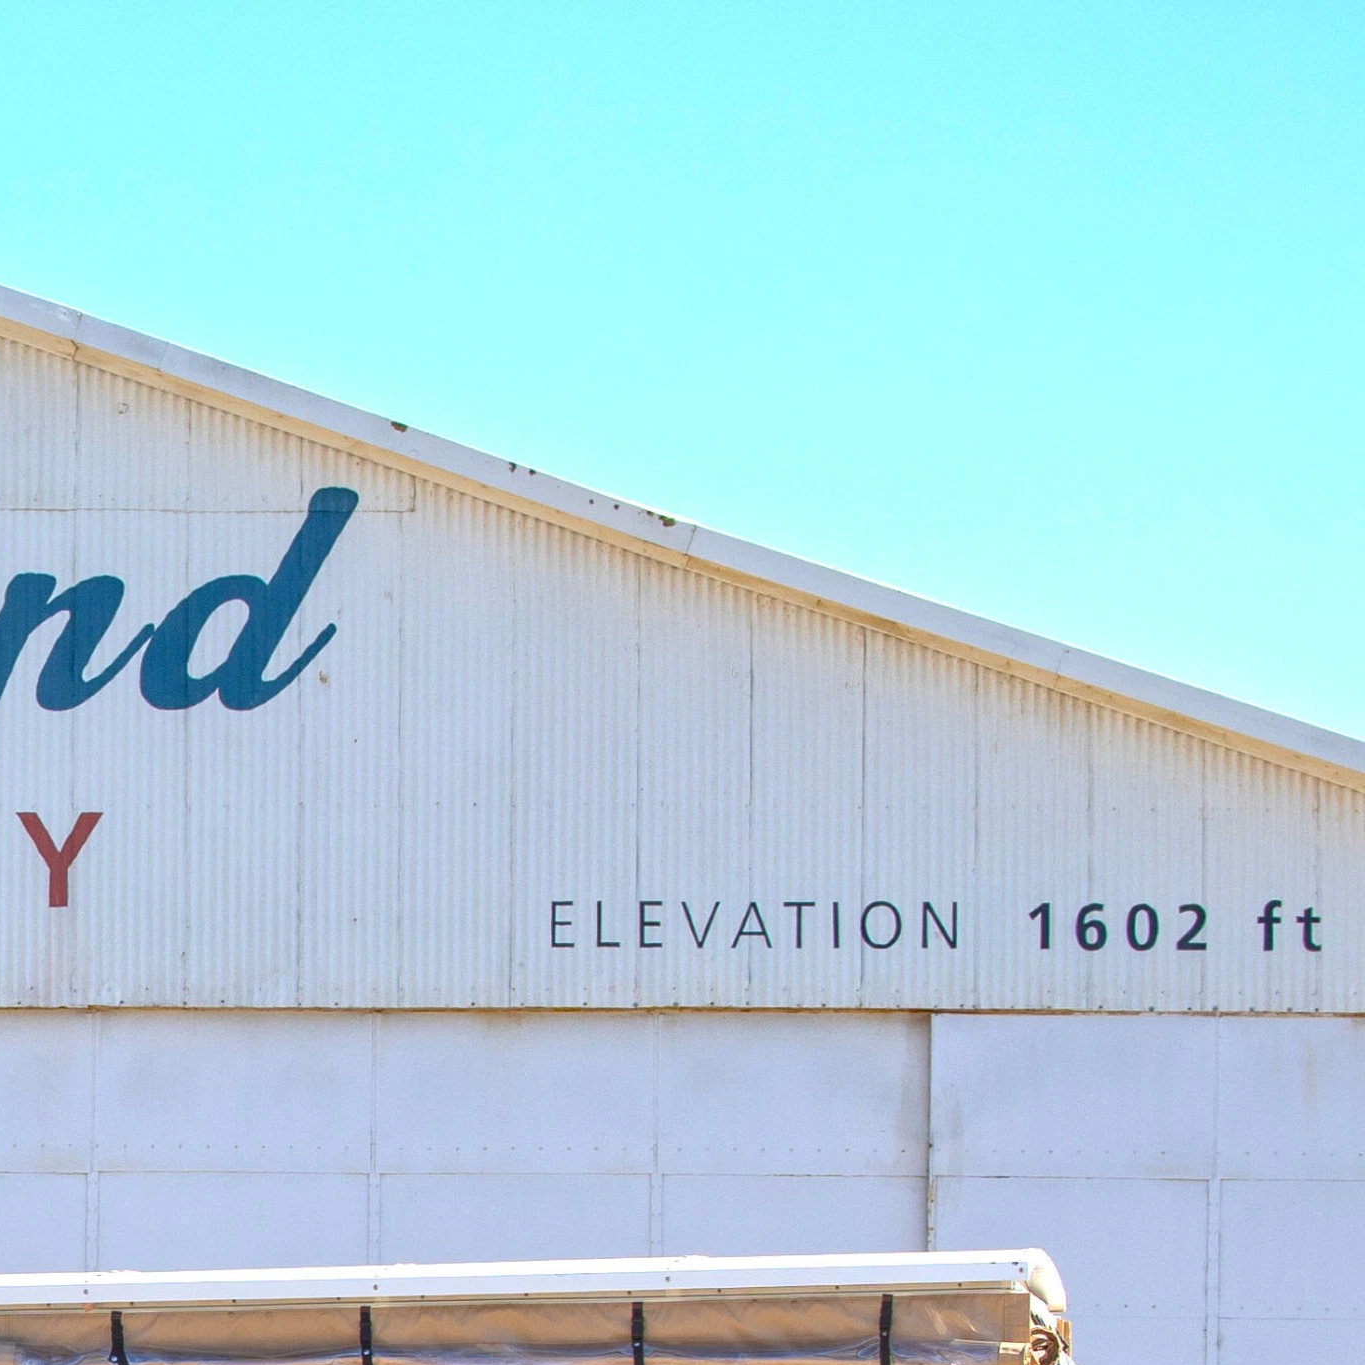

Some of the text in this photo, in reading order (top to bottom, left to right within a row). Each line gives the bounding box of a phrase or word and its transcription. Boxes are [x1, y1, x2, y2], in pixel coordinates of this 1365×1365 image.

[550, 899, 1324, 953] ELEVATION 1602 ft
